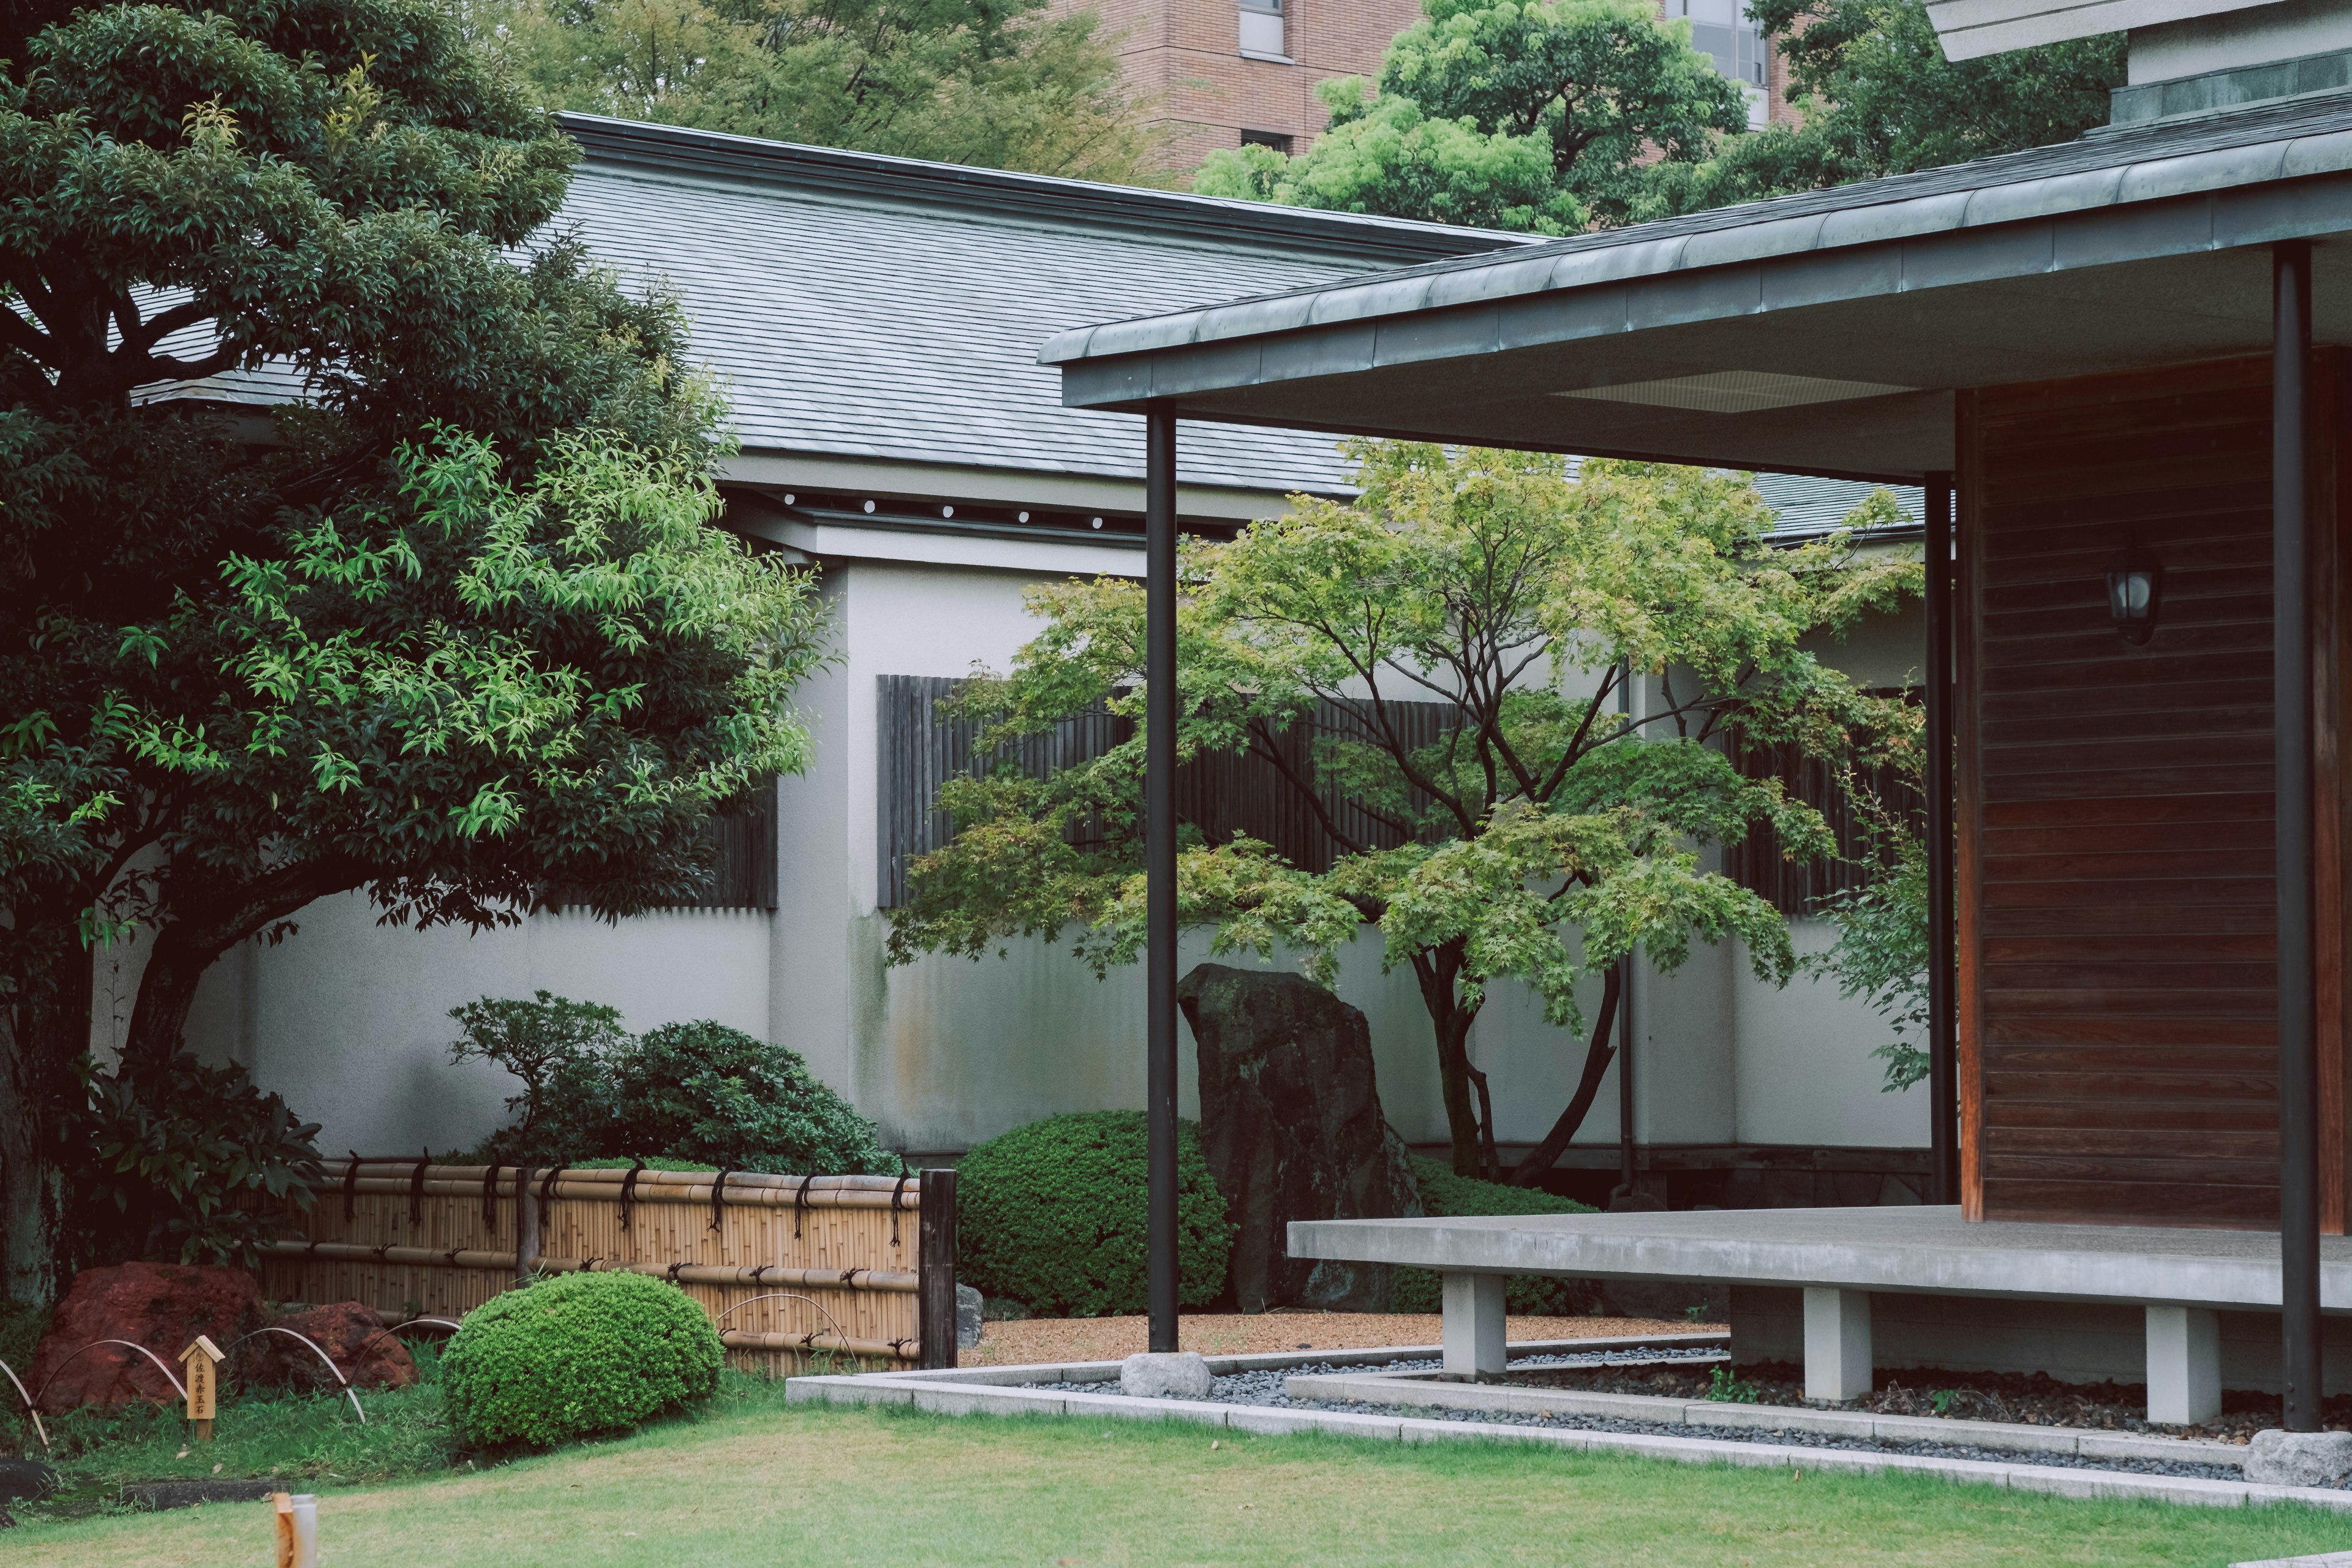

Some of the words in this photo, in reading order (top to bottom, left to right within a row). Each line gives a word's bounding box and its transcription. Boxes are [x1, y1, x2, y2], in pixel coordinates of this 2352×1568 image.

[195, 1363, 205, 1414] 佐渡赤玉石
